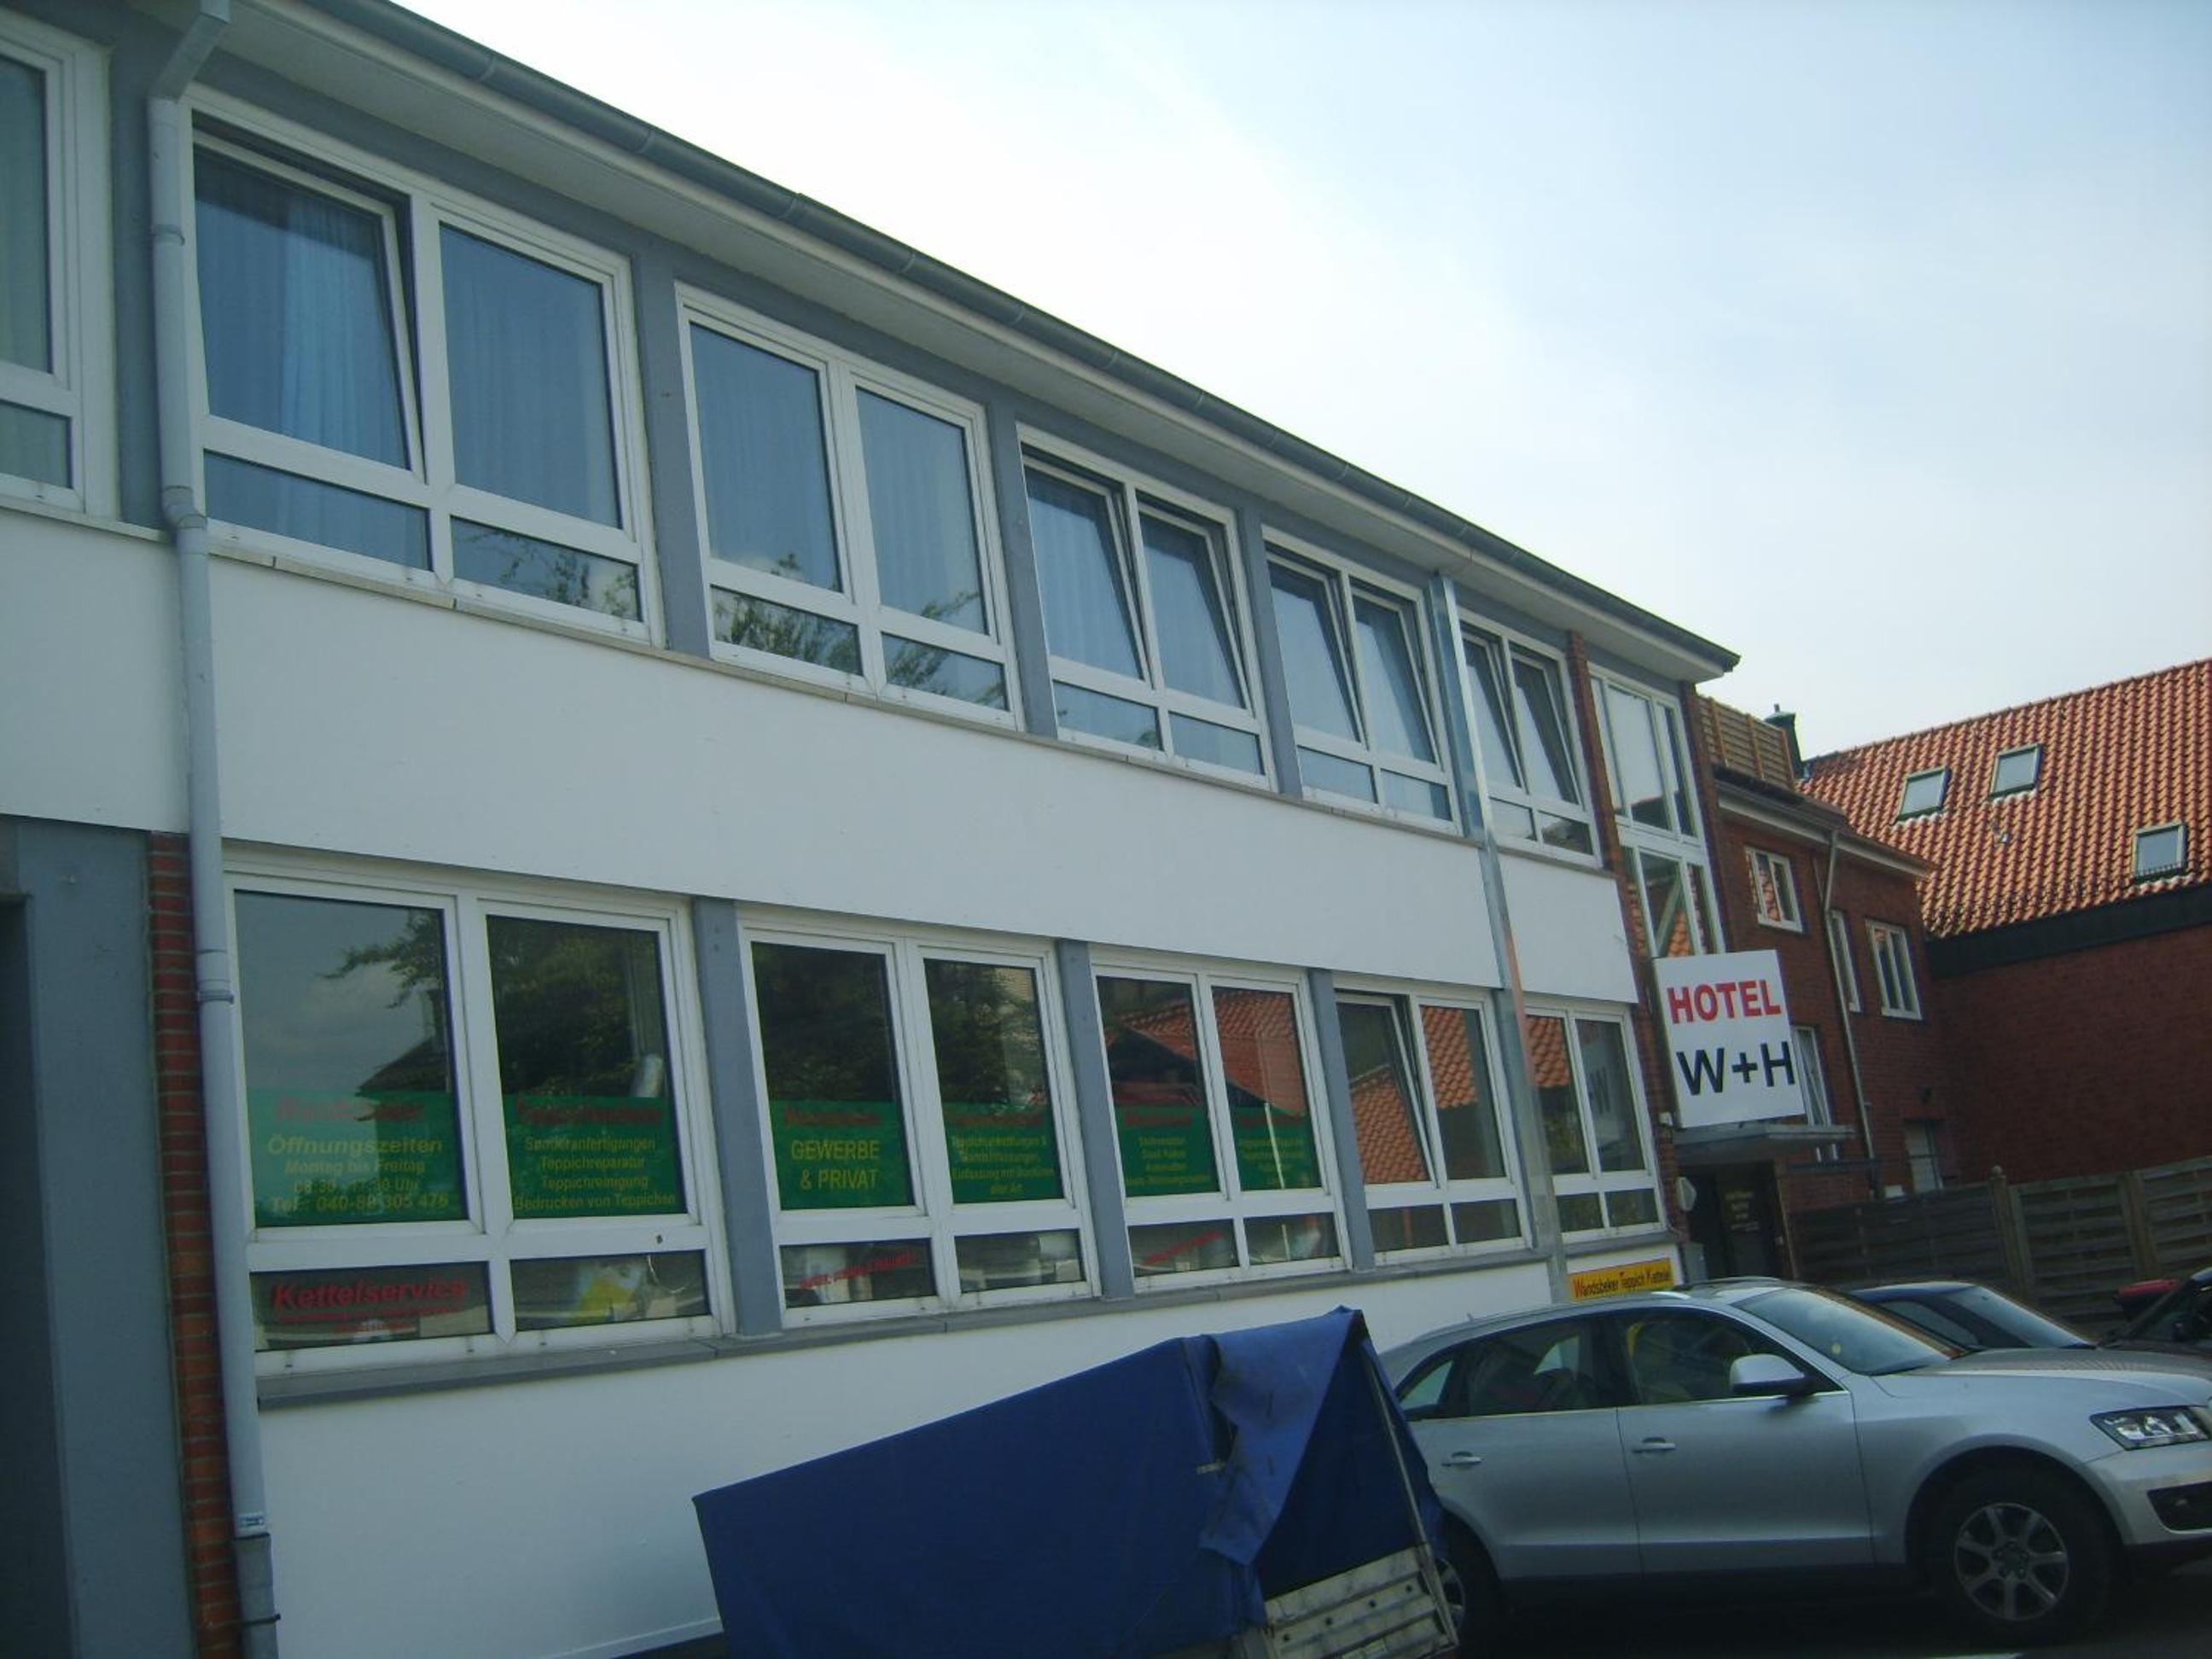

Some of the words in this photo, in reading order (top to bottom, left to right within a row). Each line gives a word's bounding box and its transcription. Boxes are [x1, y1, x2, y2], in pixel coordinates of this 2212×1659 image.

[1667, 979, 1782, 1024] HOTEL
[1676, 1040, 1796, 1096] W+H
[267, 1133, 443, 1158] Öffnungszeiten
[790, 1139, 881, 1161] GEWERBE
[374, 1158, 426, 1174] Freitag
[800, 1168, 813, 1190] &
[818, 1167, 879, 1190] PRIVAT
[272, 1278, 468, 1310] Kettelservice
